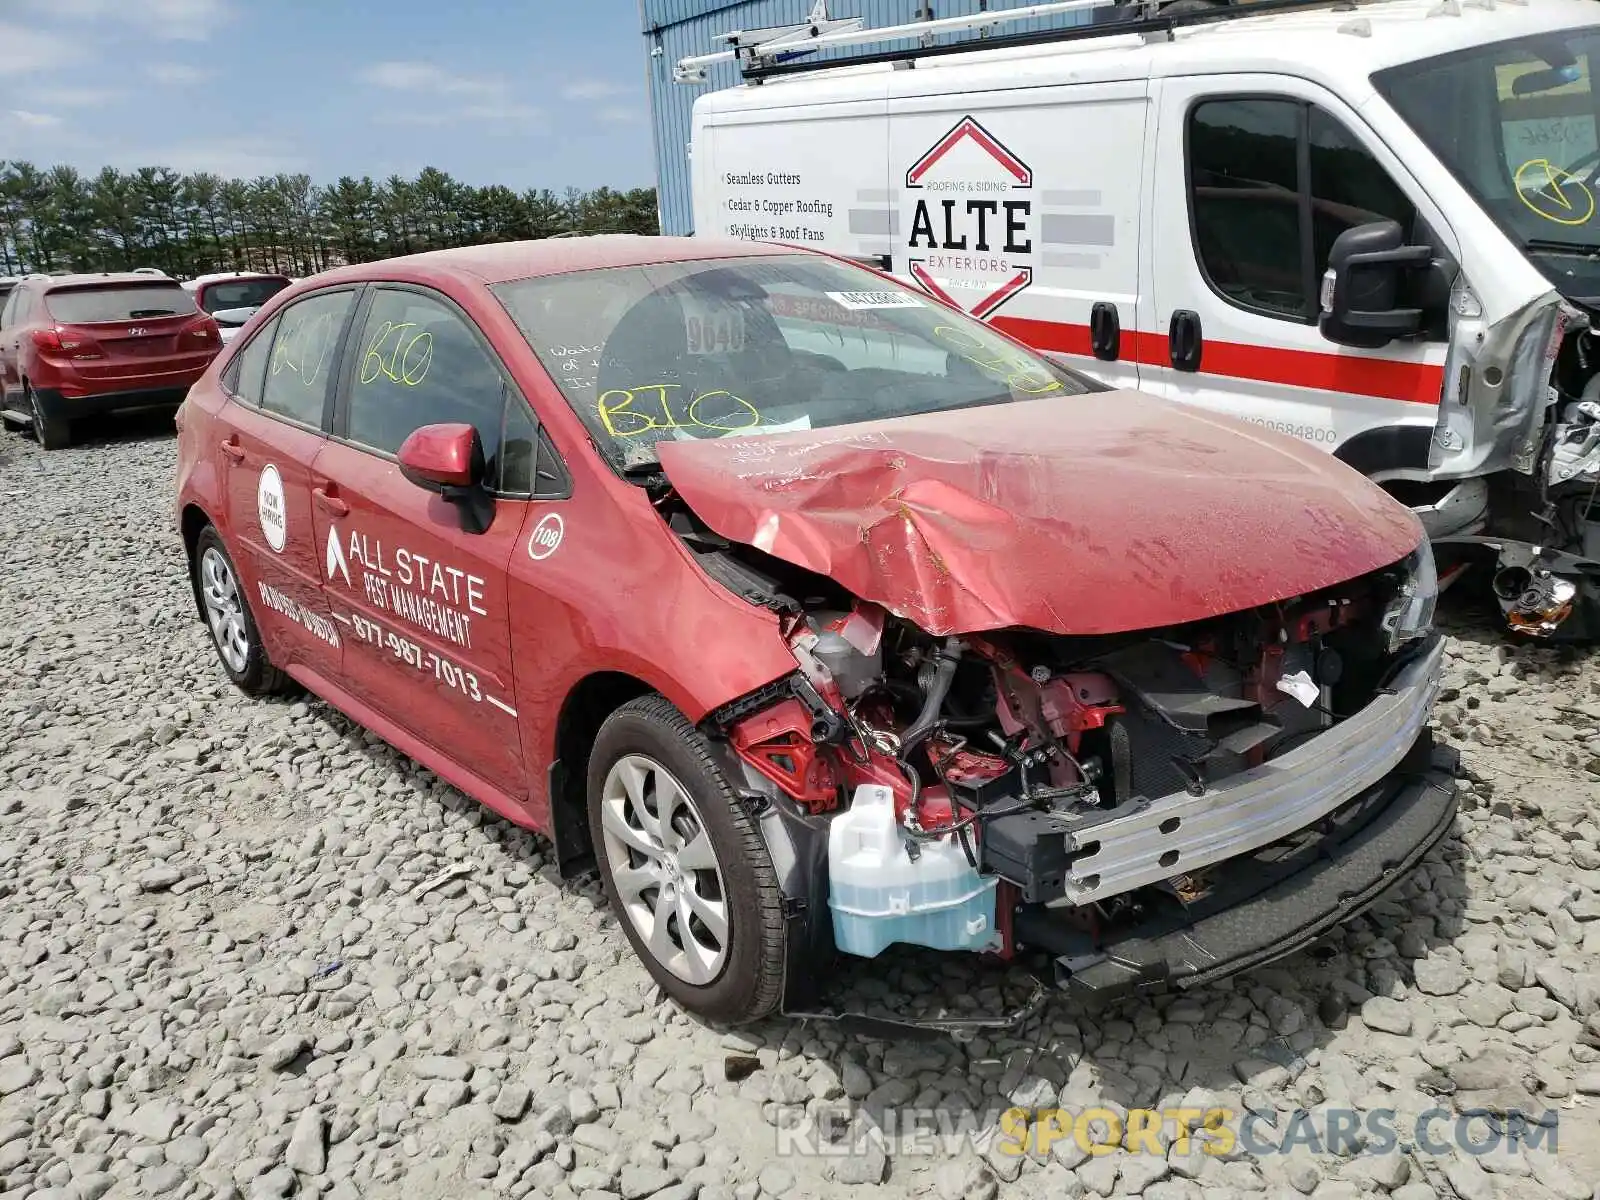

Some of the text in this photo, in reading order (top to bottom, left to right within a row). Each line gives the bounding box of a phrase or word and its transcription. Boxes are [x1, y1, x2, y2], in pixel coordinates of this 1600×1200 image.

[726, 171, 801, 186] Seamless Gutters
[927, 181, 1008, 192] ROOFING & SIDING
[728, 197, 752, 211] Cedar
[762, 199, 794, 216] Copper
[796, 199, 833, 218] Roofing
[730, 223, 769, 241] Skylights
[779, 226, 801, 240] Roof
[802, 227, 825, 241] Fans
[908, 199, 1032, 254] ALTE
[929, 255, 1008, 273] EXTERIORS
[535, 526, 558, 548] 108
[349, 530, 392, 577] ALL
[396, 547, 488, 616] STATE
[363, 571, 390, 612] PEST
[390, 583, 471, 649] MANAGEMENT
[352, 614, 482, 702] 877-987-7013
